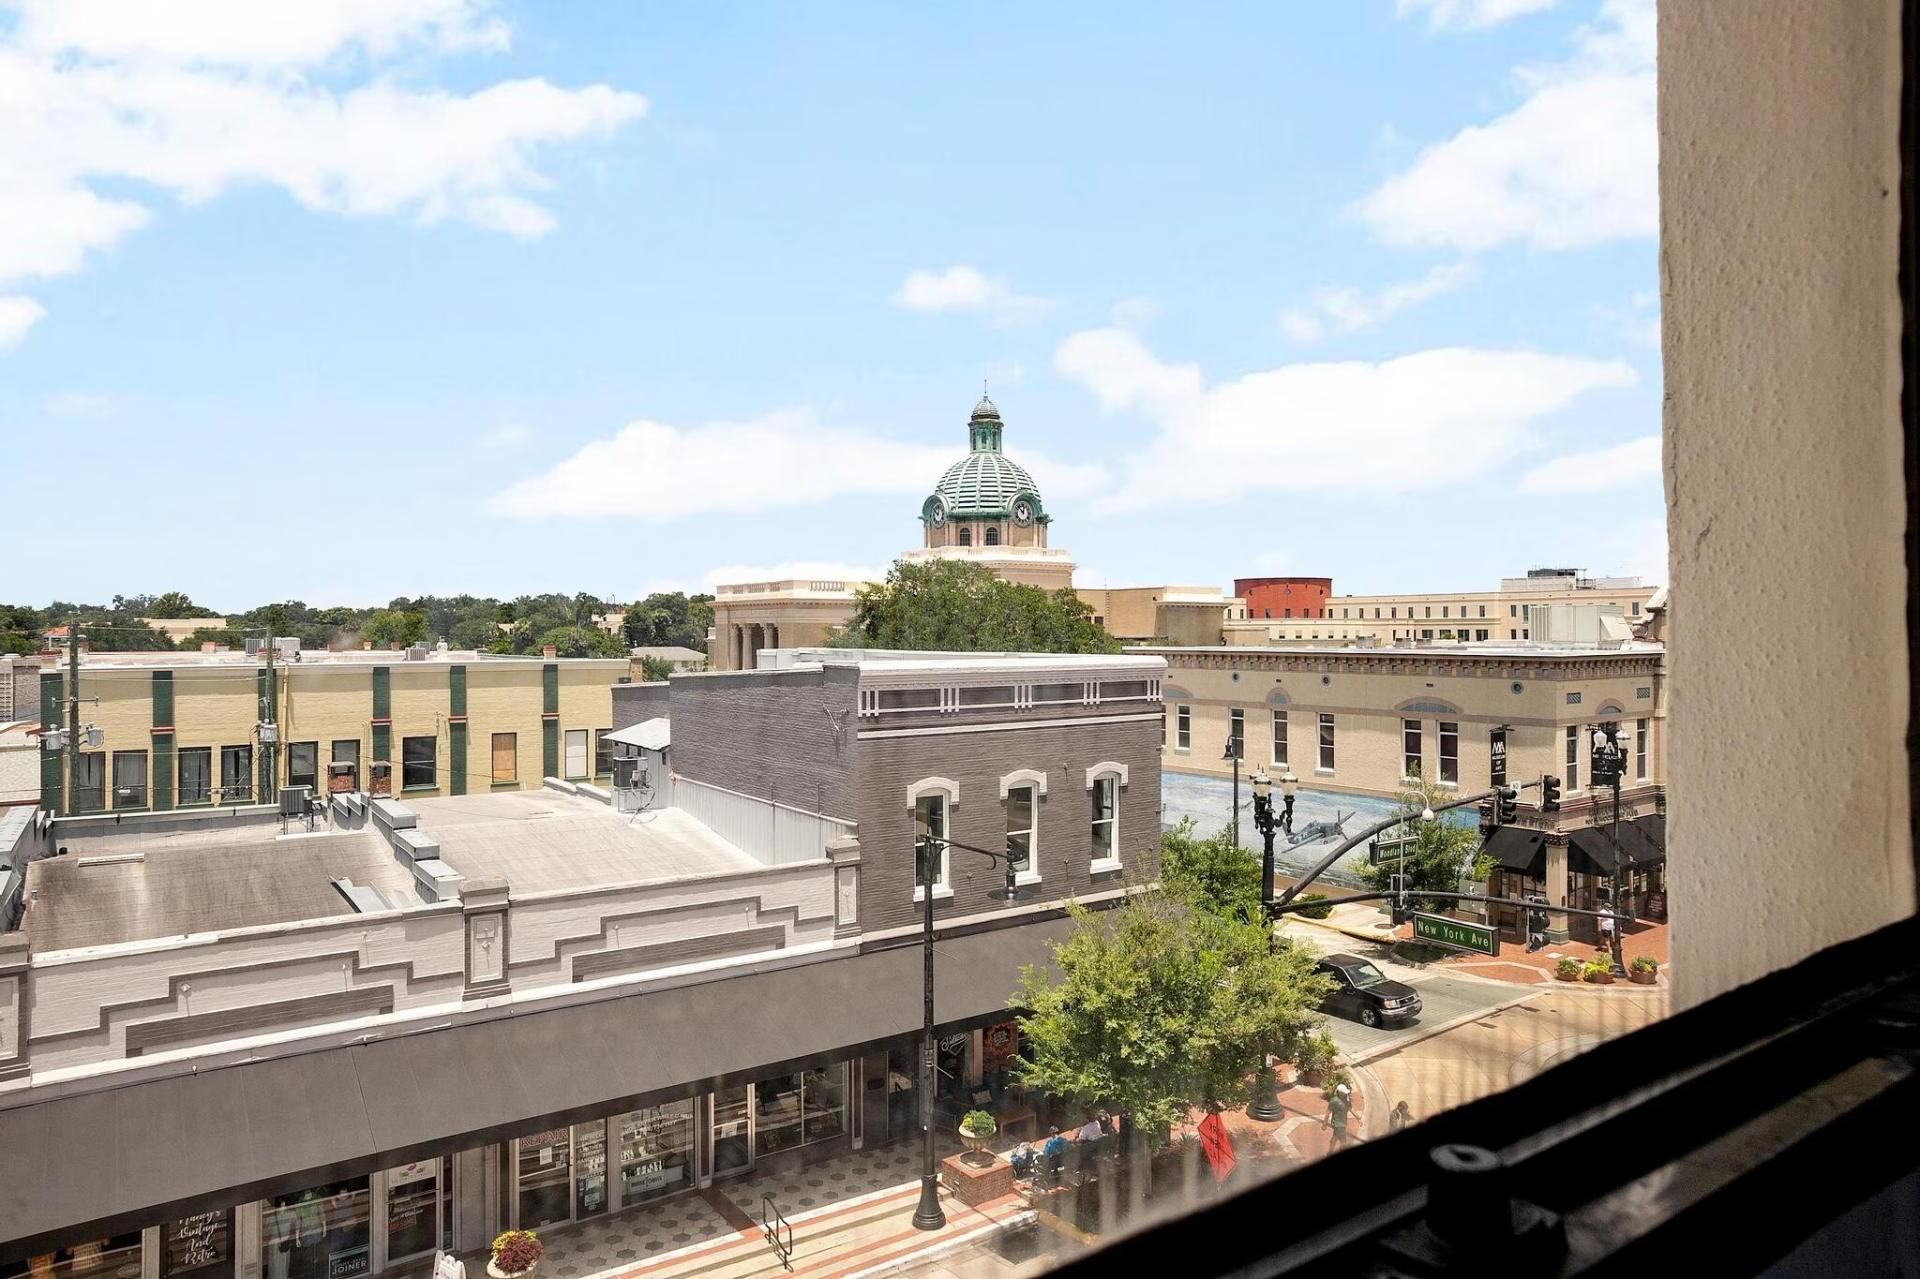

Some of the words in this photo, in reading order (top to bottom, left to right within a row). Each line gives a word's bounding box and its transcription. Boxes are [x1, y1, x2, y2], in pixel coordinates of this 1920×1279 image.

[1379, 846, 1404, 859] Woodlan
[1417, 920, 1437, 935] New
[1443, 926, 1465, 942] York
[1471, 932, 1489, 947] Ave
[331, 1259, 368, 1275] JOINER
